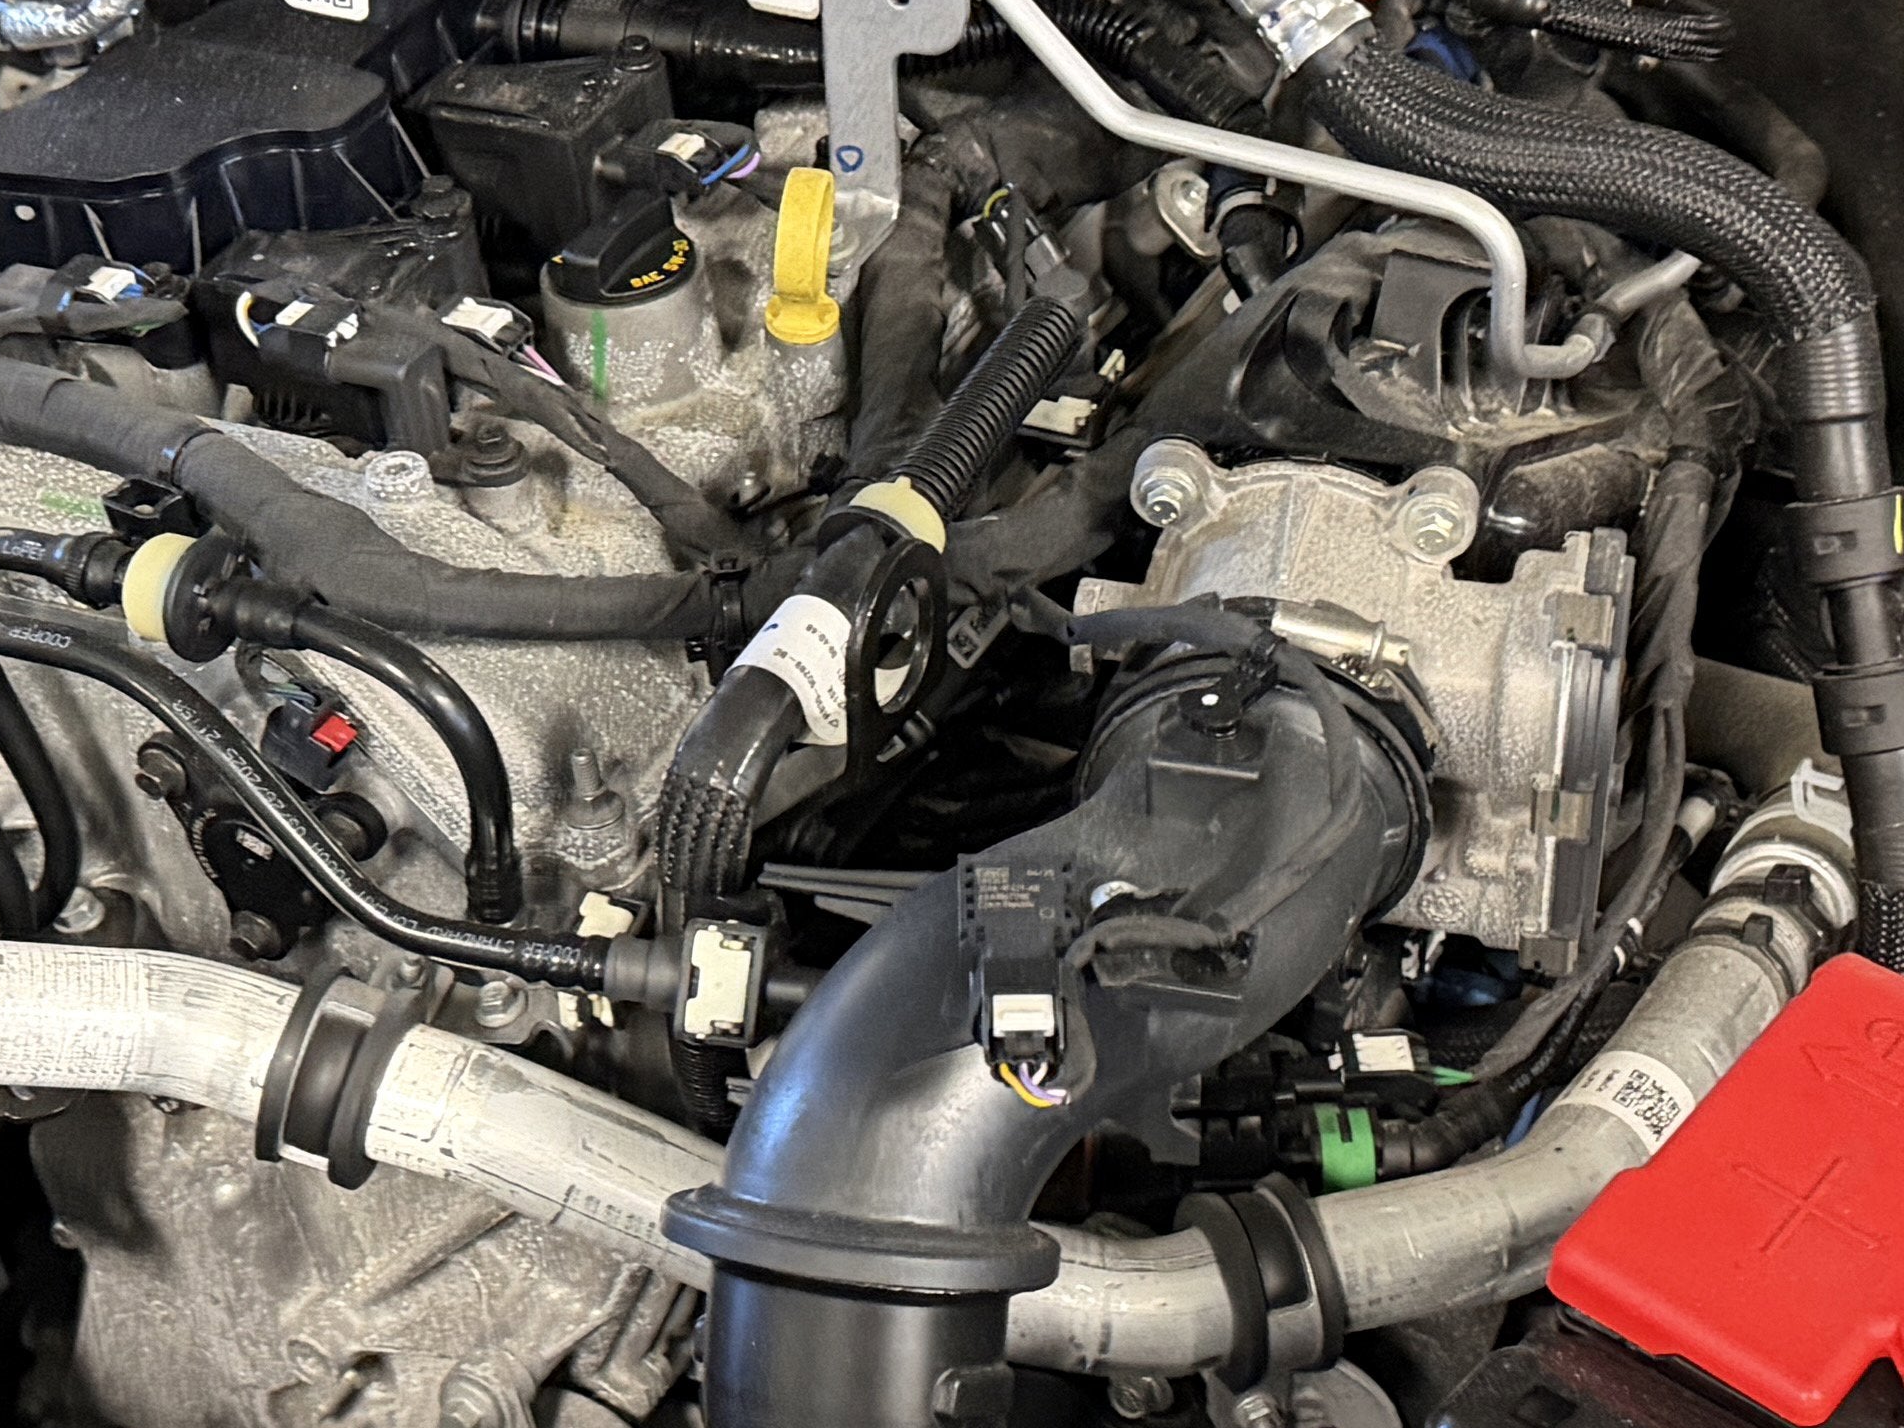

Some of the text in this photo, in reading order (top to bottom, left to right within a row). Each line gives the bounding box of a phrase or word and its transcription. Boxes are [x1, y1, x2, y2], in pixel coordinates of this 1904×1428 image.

[627, 235, 693, 295] SAE 5W-30
[8, 624, 71, 649] COOPER
